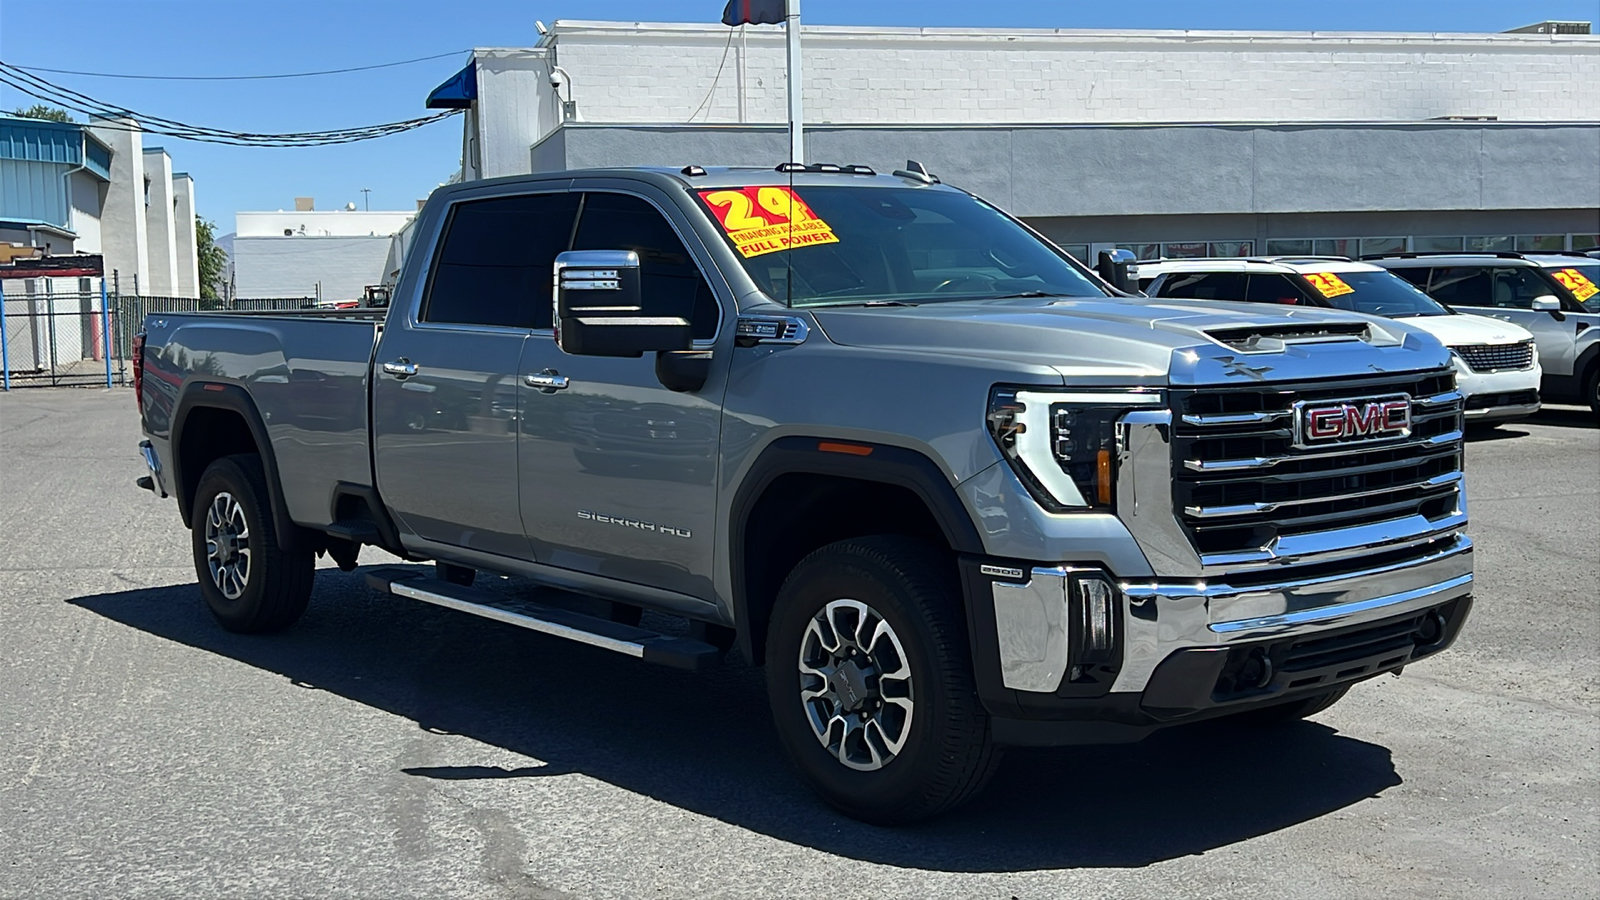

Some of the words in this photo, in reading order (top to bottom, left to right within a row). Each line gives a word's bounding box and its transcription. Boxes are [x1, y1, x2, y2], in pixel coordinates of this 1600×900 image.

[706, 187, 812, 230] 24
[733, 227, 780, 242] FINANCING
[780, 221, 825, 235] AVAILABLE
[741, 240, 779, 255] FULL
[780, 232, 833, 246] POWER
[1553, 268, 1589, 290] 25
[1306, 401, 1410, 440] GMC
[577, 510, 656, 531] SIERRA
[660, 525, 692, 538] HD
